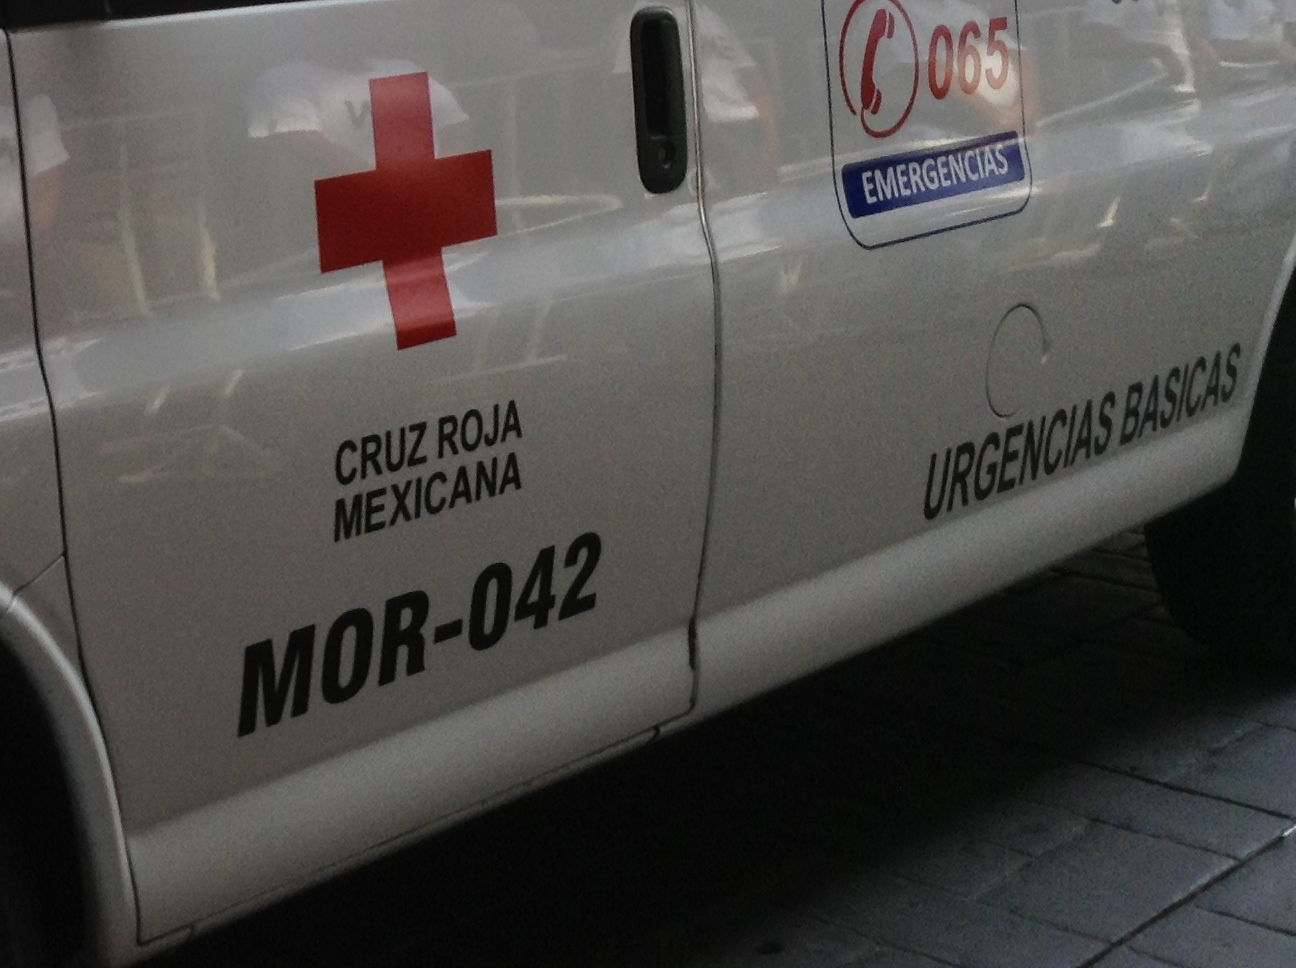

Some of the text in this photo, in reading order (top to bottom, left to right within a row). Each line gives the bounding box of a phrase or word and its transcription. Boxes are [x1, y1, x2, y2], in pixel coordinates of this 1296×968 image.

[927, 17, 1009, 100] 065
[862, 145, 1009, 205] EMERGENCIAS
[335, 400, 523, 485] CRUZ ROJA
[924, 343, 1241, 521] URGENCIAS BASICAS
[333, 452, 523, 542] MEXICANA
[237, 531, 603, 738] MOR-042
